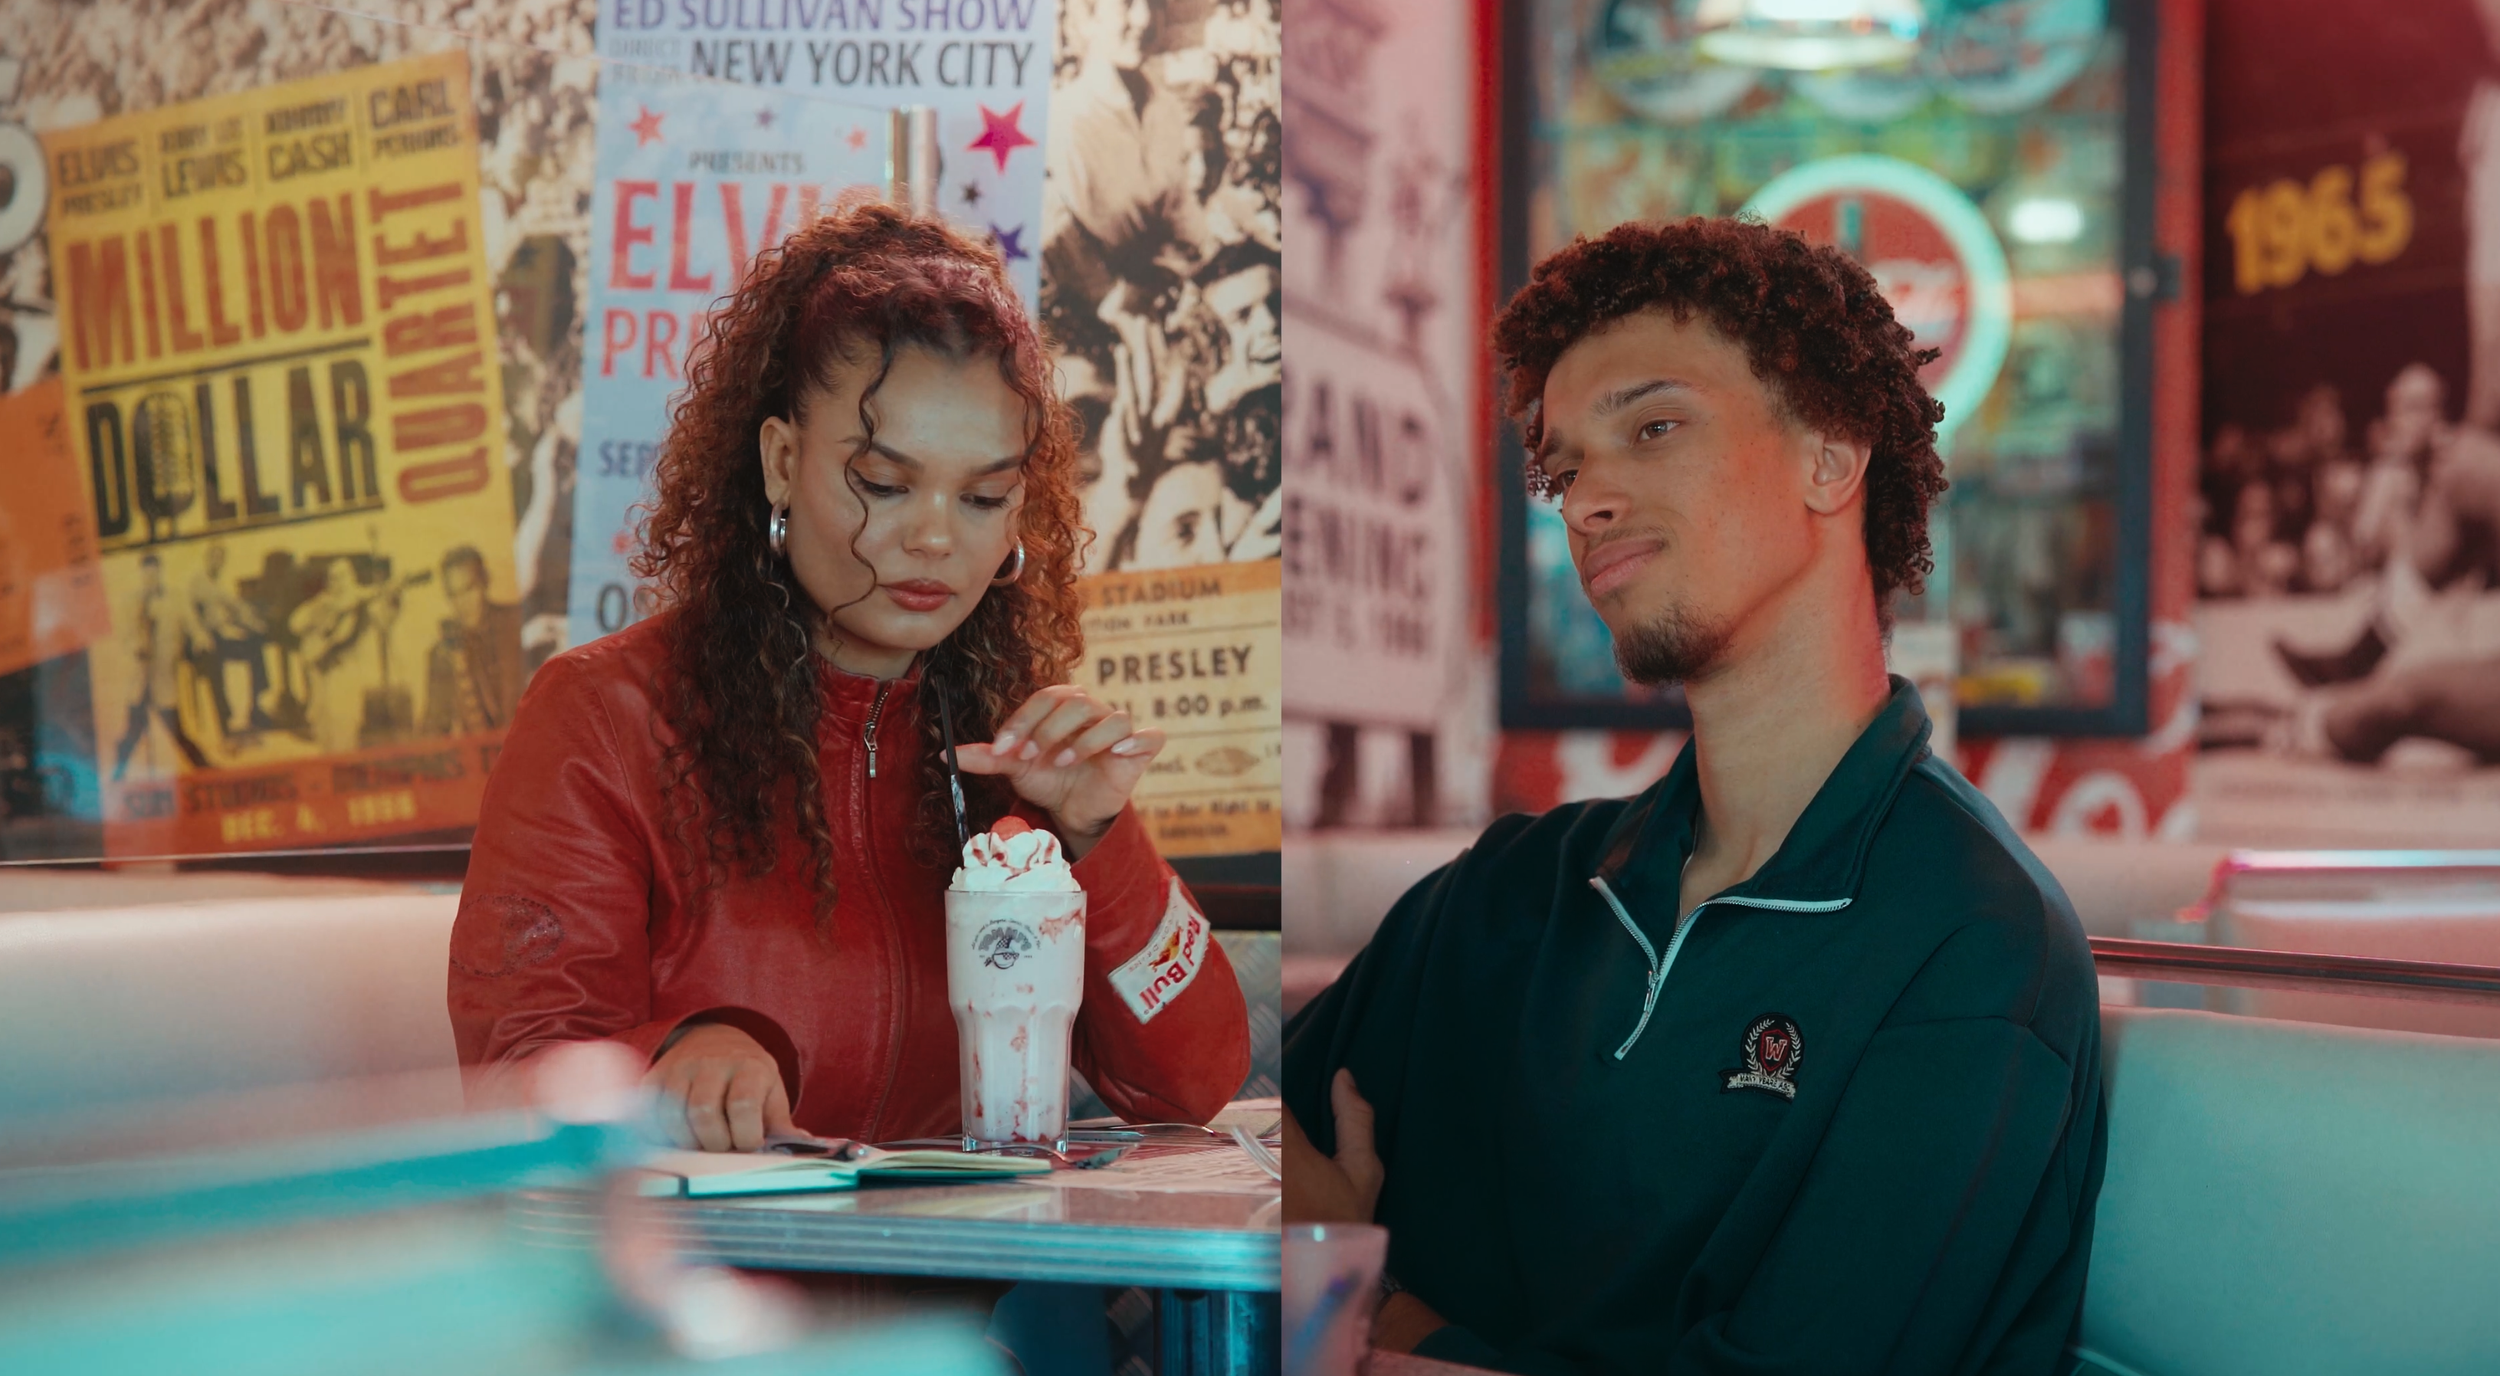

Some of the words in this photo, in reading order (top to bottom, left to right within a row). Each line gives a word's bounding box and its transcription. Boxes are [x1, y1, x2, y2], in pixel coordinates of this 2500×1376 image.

[614, 0, 664, 30] ED
[678, 0, 882, 30] SULLIVAN
[896, 0, 1035, 30] SHOW
[691, 38, 794, 84] NEW
[806, 40, 922, 86] YORK
[937, 40, 1034, 87] CITY
[369, 77, 457, 130] CARL
[57, 136, 139, 187] ELVIS
[160, 148, 248, 200] LEWIS
[268, 130, 354, 182] CASH
[688, 150, 807, 174] PRESENTS
[2225, 150, 2415, 296] 1965
[65, 190, 366, 374] MILLION
[368, 182, 491, 504] QUARTET
[85, 357, 381, 541] DOLLAR
[1102, 577, 1221, 607] STADIUM
[1097, 645, 1252, 685] PRESLEY
[1182, 911, 1202, 967] Red
[1138, 960, 1188, 1011] Bull
[1765, 1036, 1788, 1061] W
